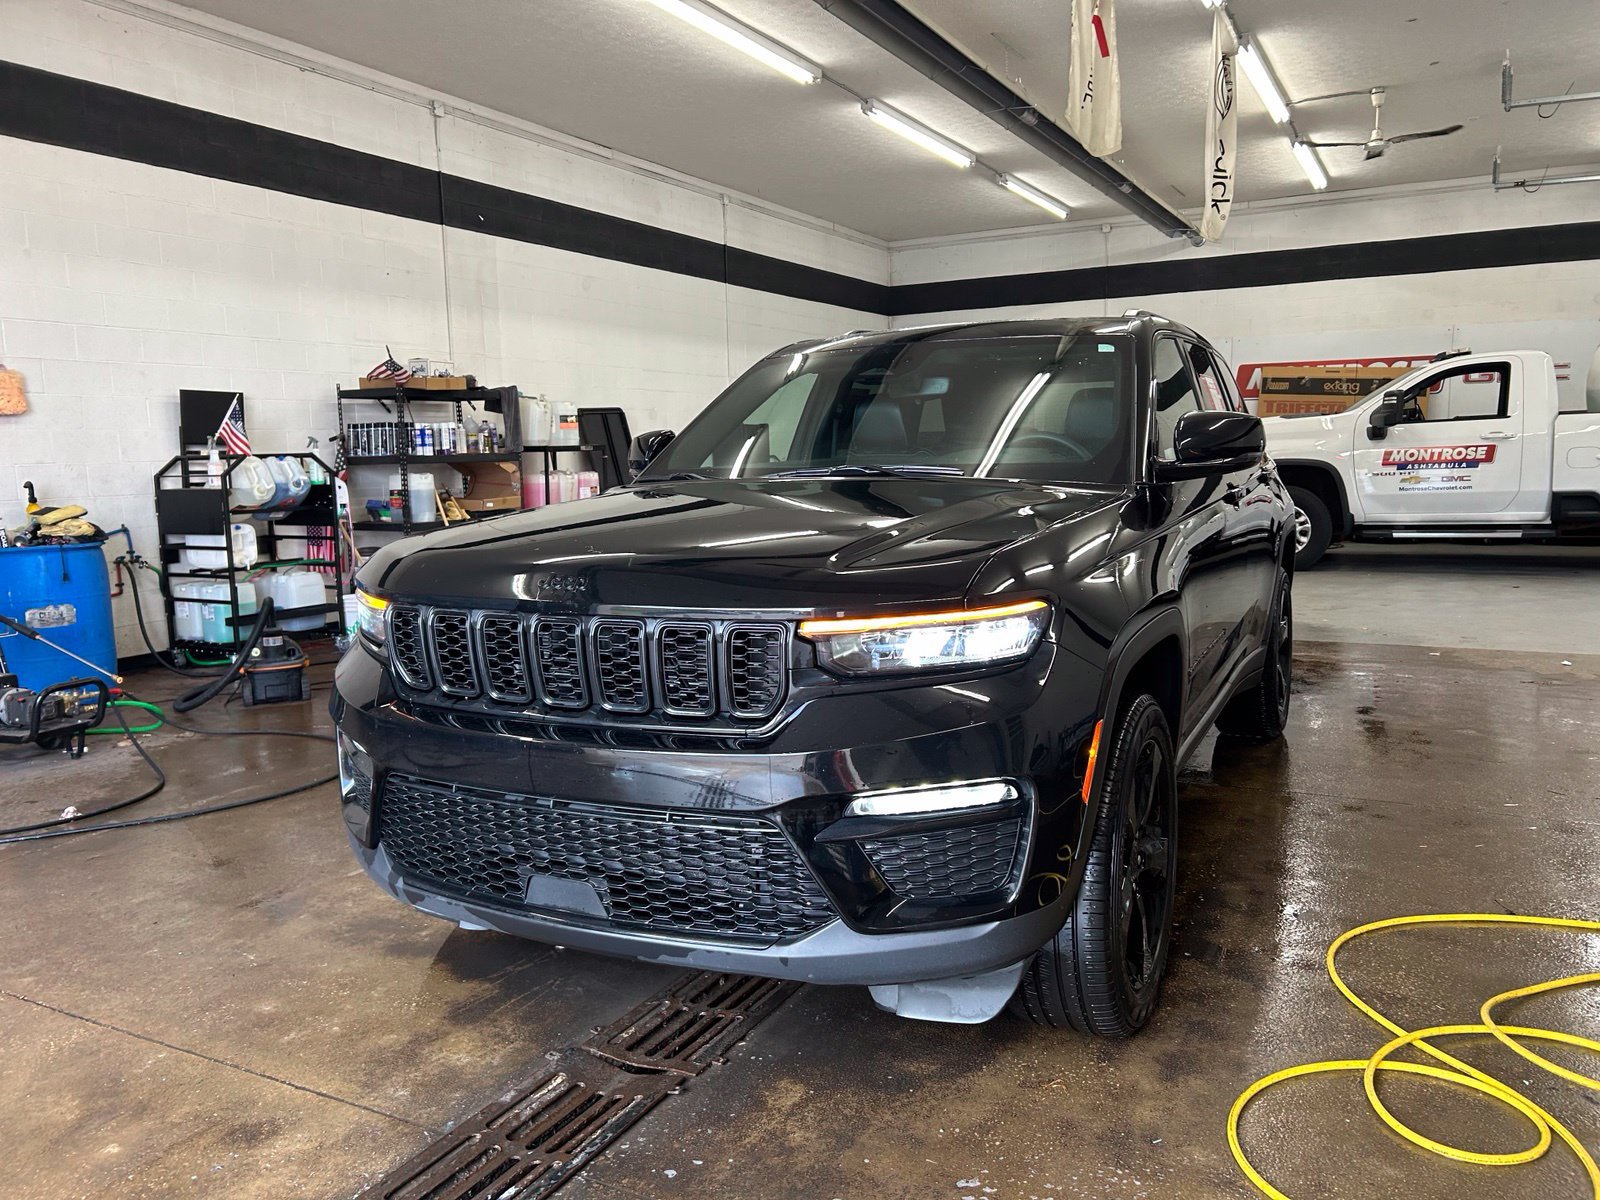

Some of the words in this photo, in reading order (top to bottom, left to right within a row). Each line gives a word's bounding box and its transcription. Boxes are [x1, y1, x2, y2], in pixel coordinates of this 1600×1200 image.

[1388, 446, 1488, 463] MONTROSE
[1406, 461, 1468, 470] ASHTABULA
[1441, 475, 1472, 483] GMC
[1398, 484, 1473, 492] MontroseChevrolet.com
